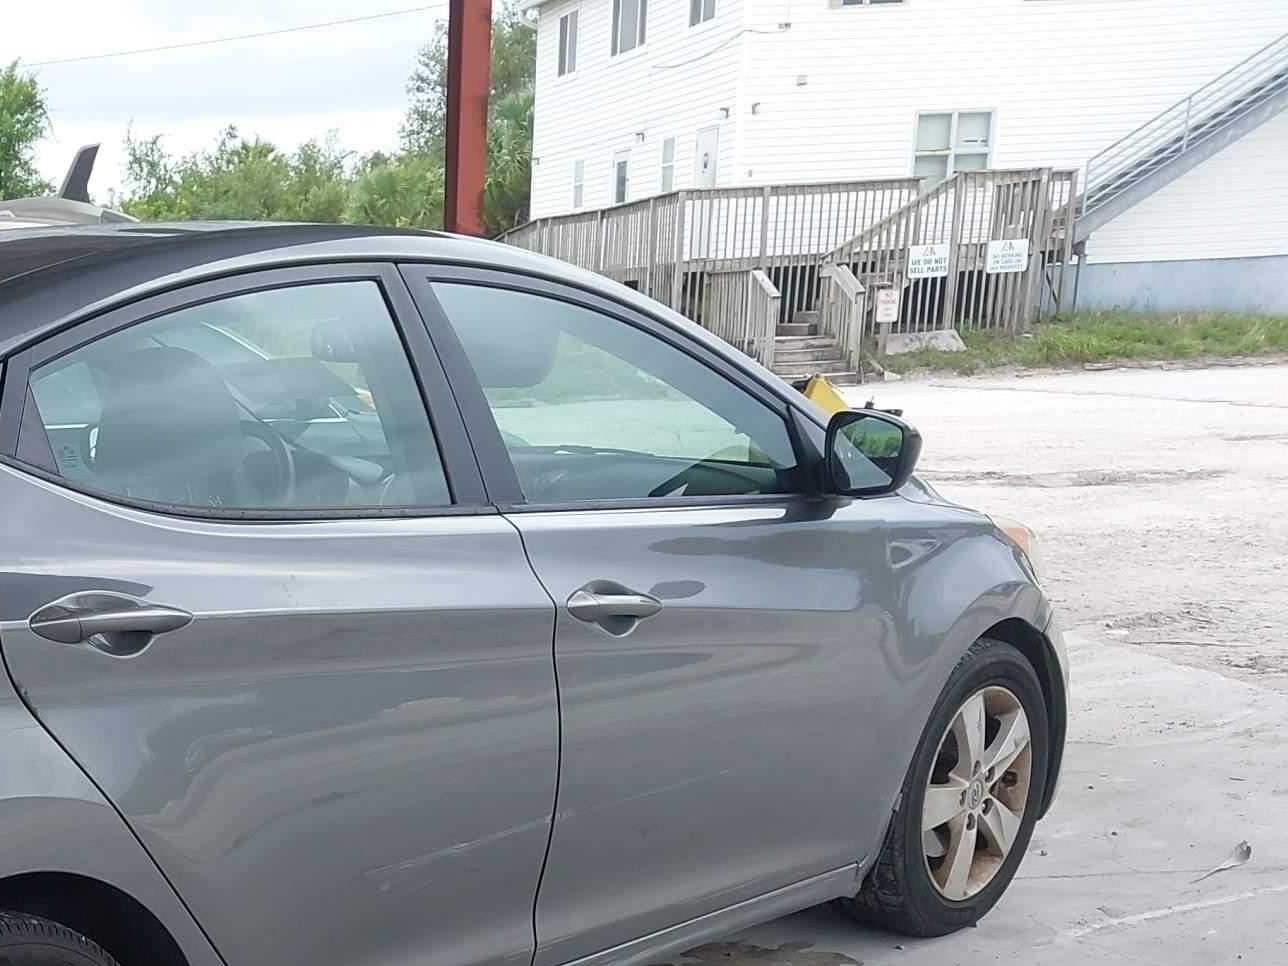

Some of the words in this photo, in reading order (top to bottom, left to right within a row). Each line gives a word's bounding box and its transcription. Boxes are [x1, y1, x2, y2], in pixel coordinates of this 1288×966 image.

[911, 258, 921, 266] WE
[934, 256, 948, 265] NOT
[910, 267, 925, 275] SELL
[926, 265, 948, 273] PARTS
